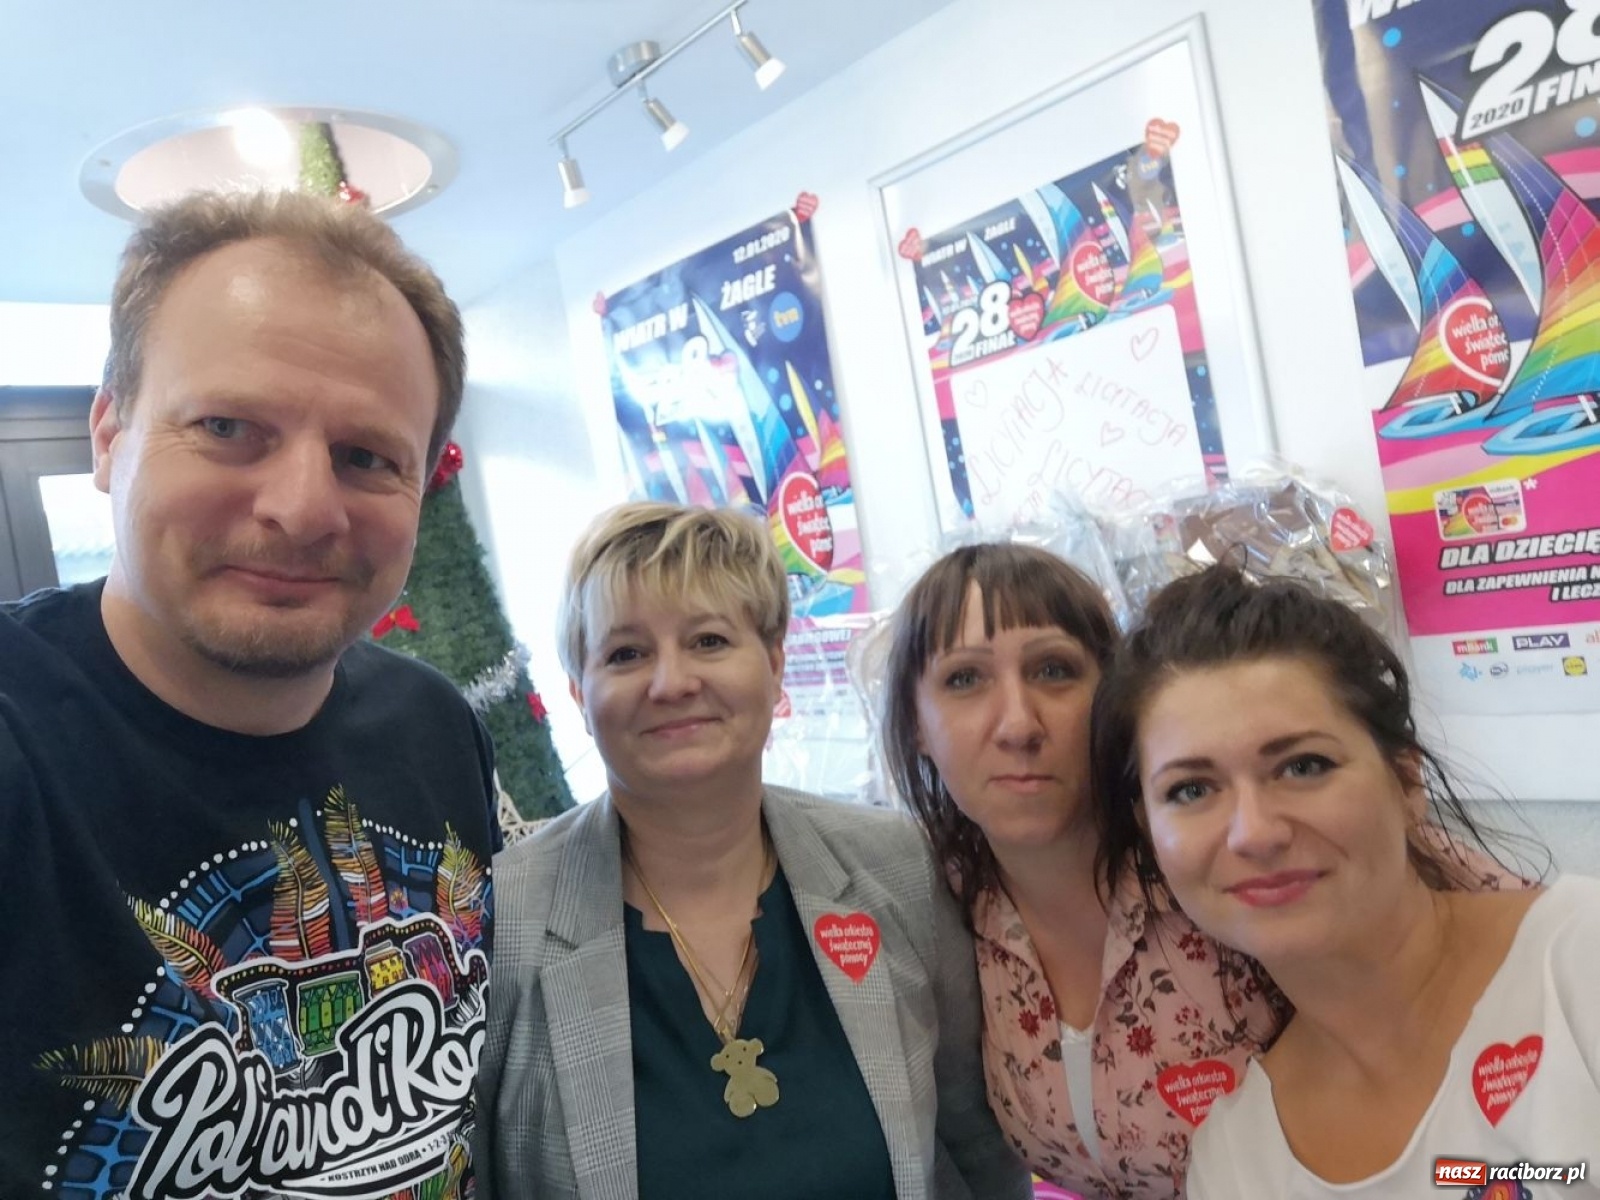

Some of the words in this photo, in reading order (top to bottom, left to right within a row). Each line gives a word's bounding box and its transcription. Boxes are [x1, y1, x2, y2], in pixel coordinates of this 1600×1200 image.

[1471, 99, 1523, 130] 2020
[720, 264, 777, 312] ŻAGLE
[951, 281, 1012, 367] 28
[1452, 313, 1488, 338] wielka
[1441, 544, 1490, 568] DLA
[1446, 580, 1475, 594] DLA
[1477, 566, 1587, 588] ZAPEWNIENIA
[1552, 587, 1559, 600] I
[1515, 635, 1564, 649] PLAY
[328, 1165, 378, 1182] KOSTRZYN
[380, 1160, 399, 1173] NAD
